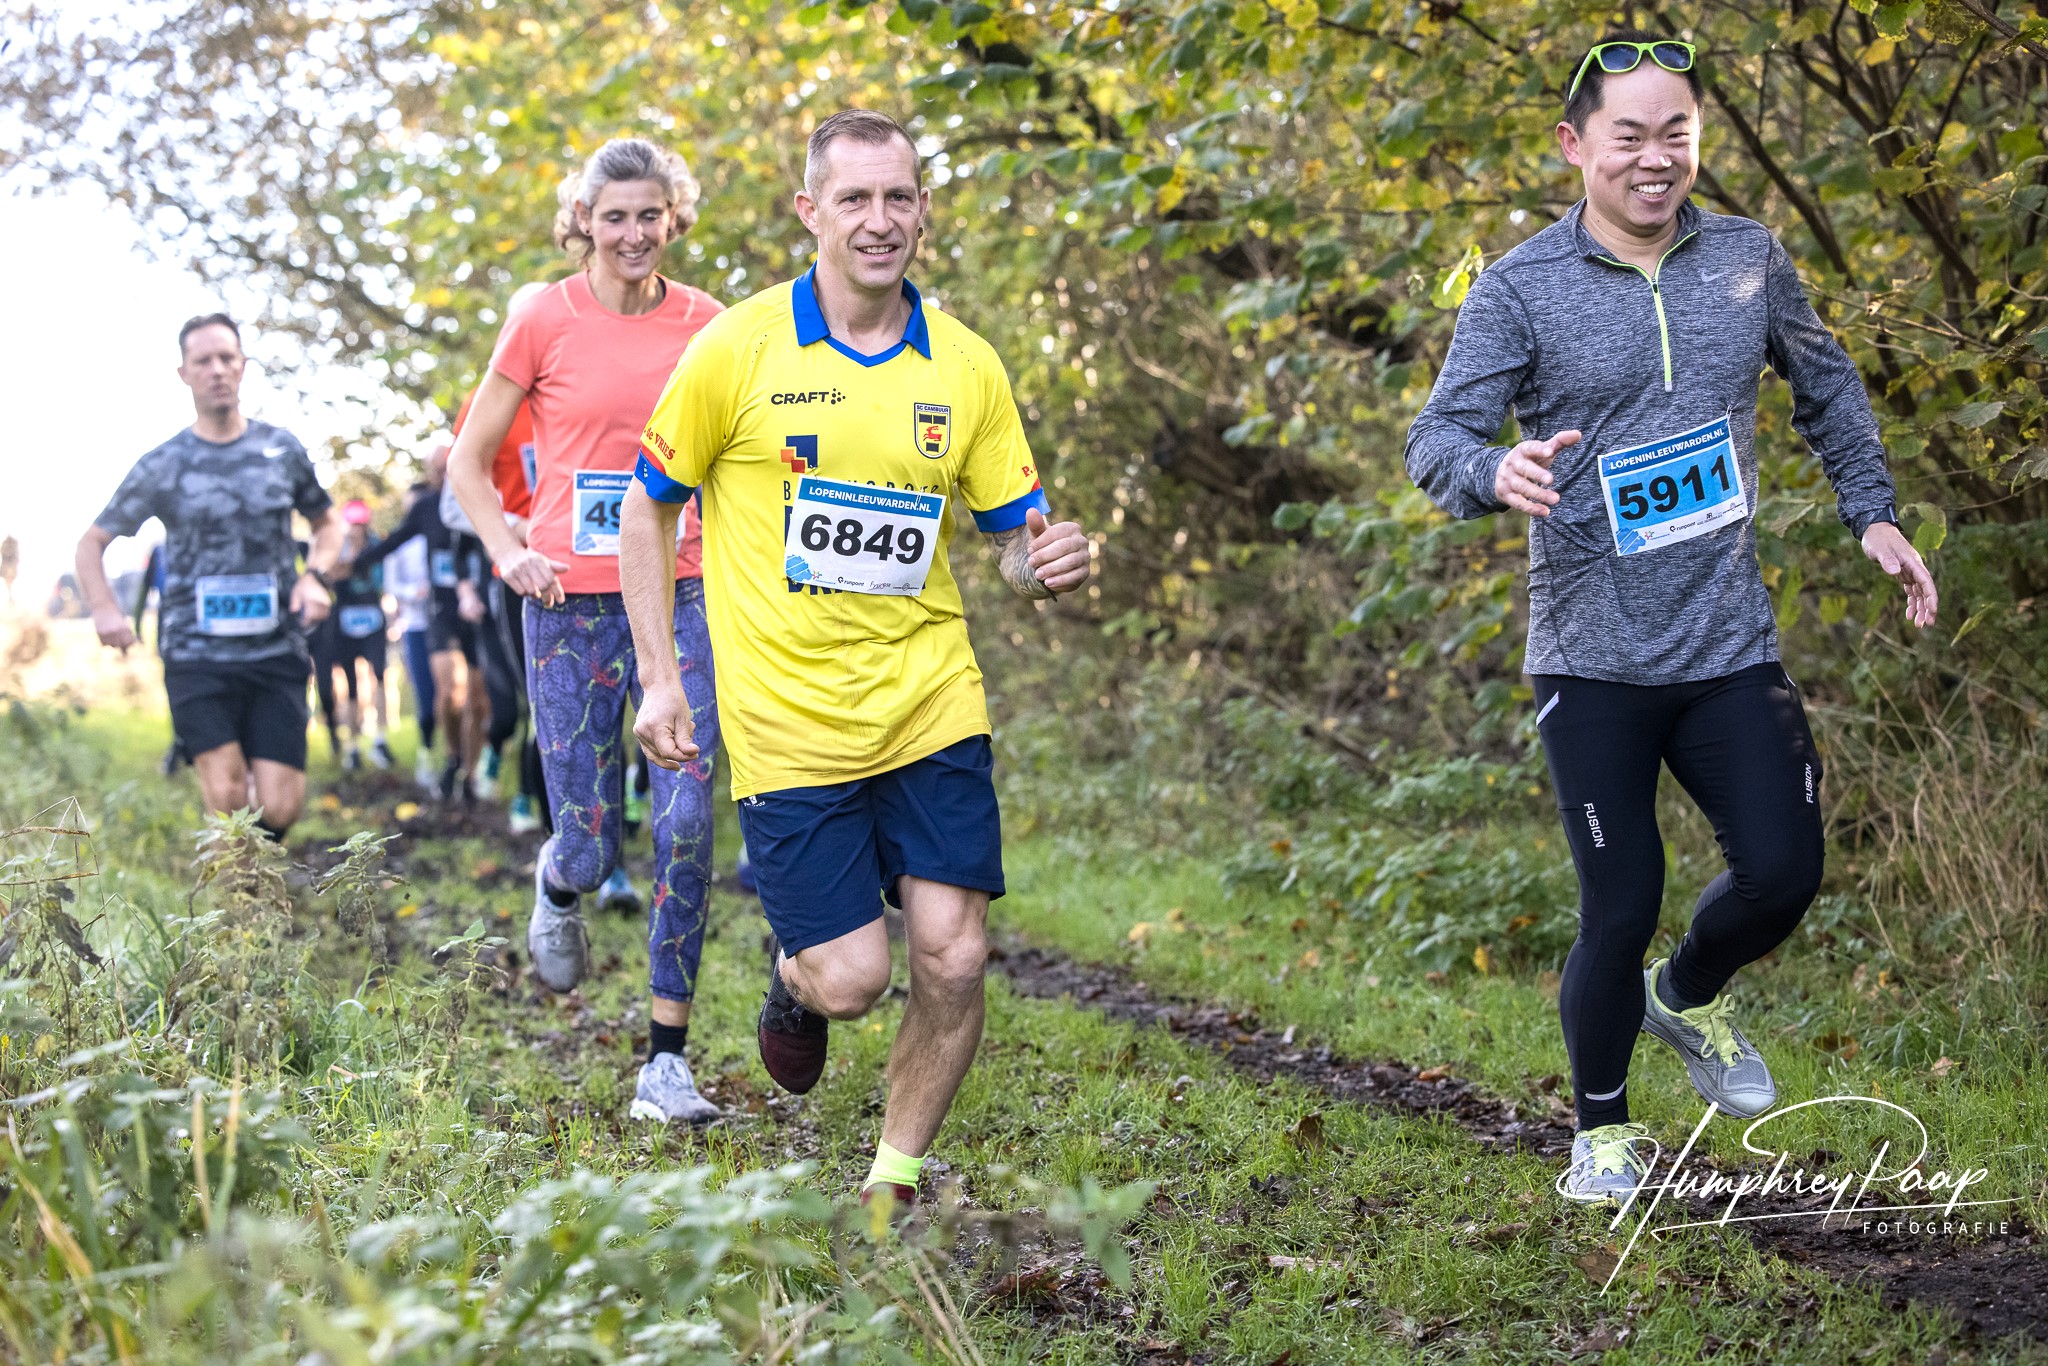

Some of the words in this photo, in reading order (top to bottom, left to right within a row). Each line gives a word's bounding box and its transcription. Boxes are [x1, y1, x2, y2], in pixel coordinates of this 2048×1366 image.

[770, 391, 829, 405] CRAFT
[655, 432, 676, 460] VRIES
[1609, 427, 1725, 470] LOPENINLEEUWARDEN.NL
[808, 486, 932, 513] LOPENINLEEUWARDEN.NL
[1618, 454, 1730, 521] 5911
[585, 501, 621, 528] 49
[800, 513, 925, 565] 6849
[1805, 763, 1814, 804] FUSION
[1583, 803, 1606, 848] FUSION
